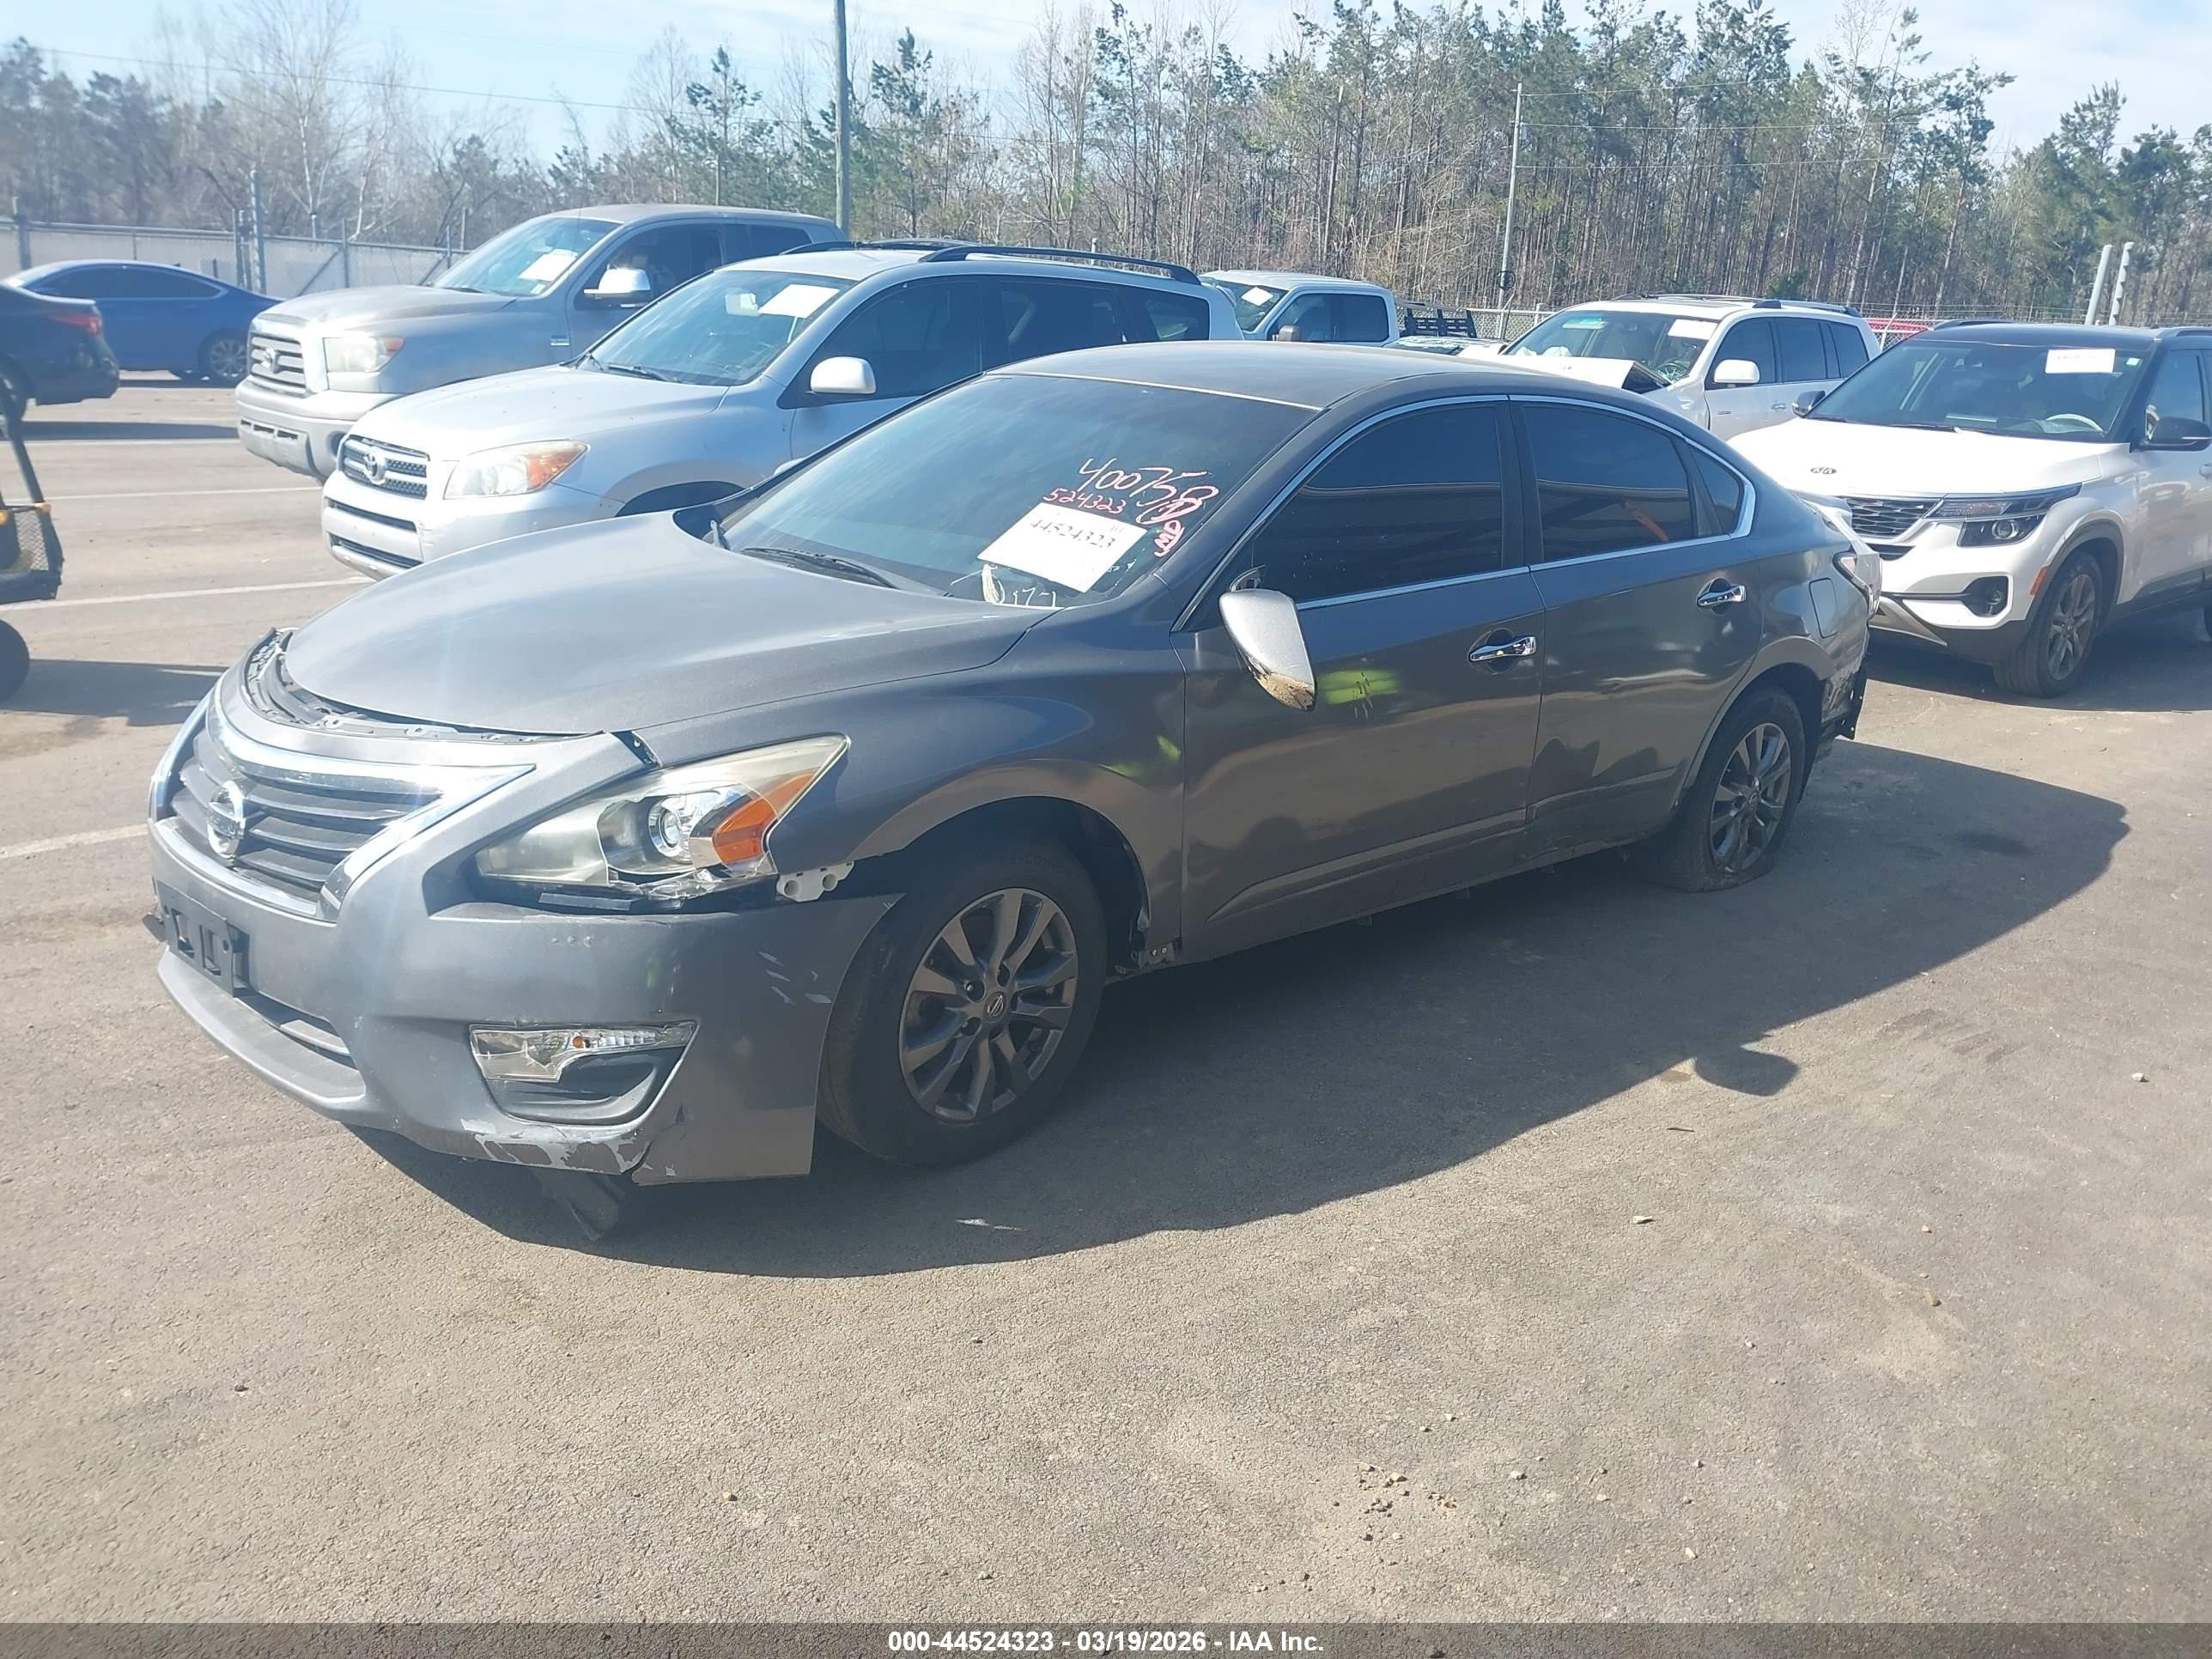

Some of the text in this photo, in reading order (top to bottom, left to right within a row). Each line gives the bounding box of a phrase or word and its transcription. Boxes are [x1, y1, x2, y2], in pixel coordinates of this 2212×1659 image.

[1809, 466, 1838, 475] KIA
[1042, 487, 1127, 514] 524323
[1030, 519, 1116, 548] 44524323
